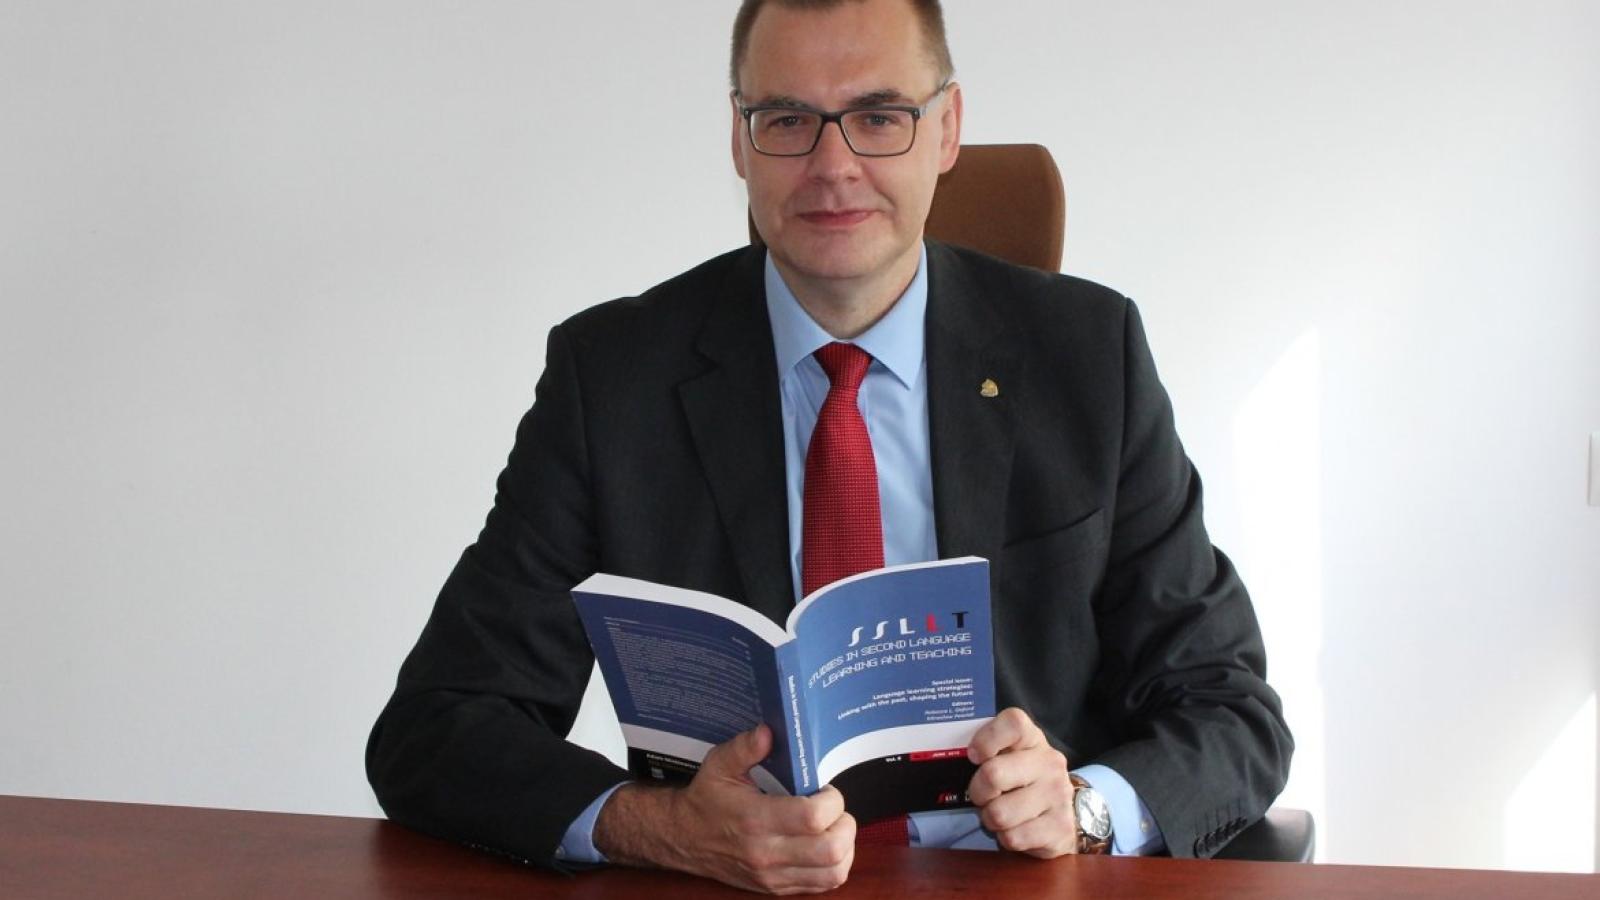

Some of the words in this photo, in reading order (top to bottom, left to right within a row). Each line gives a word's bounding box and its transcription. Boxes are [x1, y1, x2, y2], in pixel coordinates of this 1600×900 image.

[808, 656, 845, 689] STUDIES
[846, 651, 859, 662] IN
[860, 639, 906, 657] SECOND
[909, 633, 972, 648] LANGUAGE
[822, 660, 878, 688] LEARNING
[881, 653, 906, 666] AND
[911, 646, 972, 662] TEACHING
